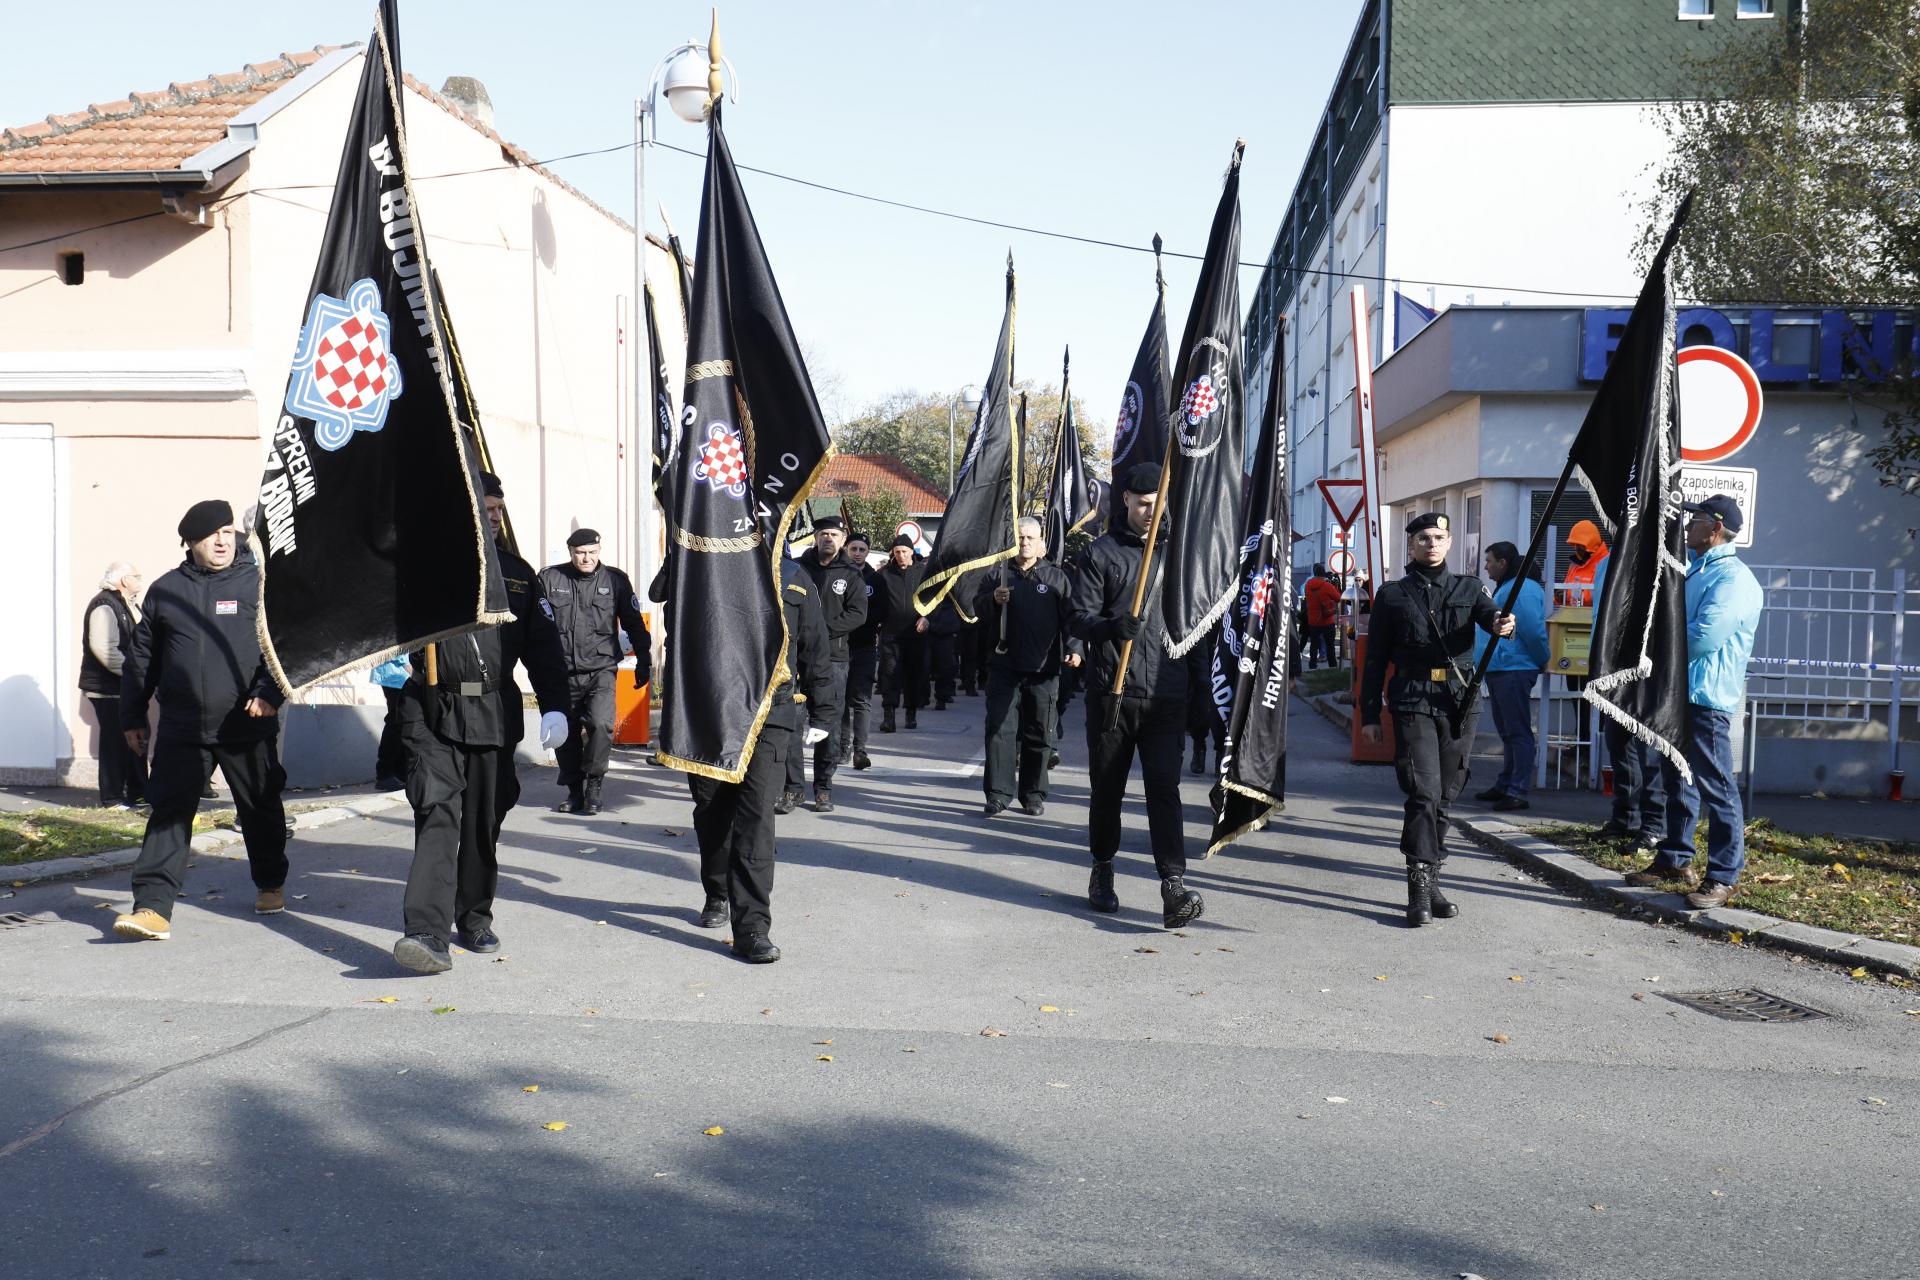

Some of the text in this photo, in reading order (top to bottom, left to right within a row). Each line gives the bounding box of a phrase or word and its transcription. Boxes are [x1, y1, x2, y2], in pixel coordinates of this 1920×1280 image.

[275, 414, 317, 506] SPREMNI
[1682, 476, 1748, 494] zaposlenika,
[1626, 486, 1638, 529] BOJNA
[1240, 583, 1251, 618] DOM
